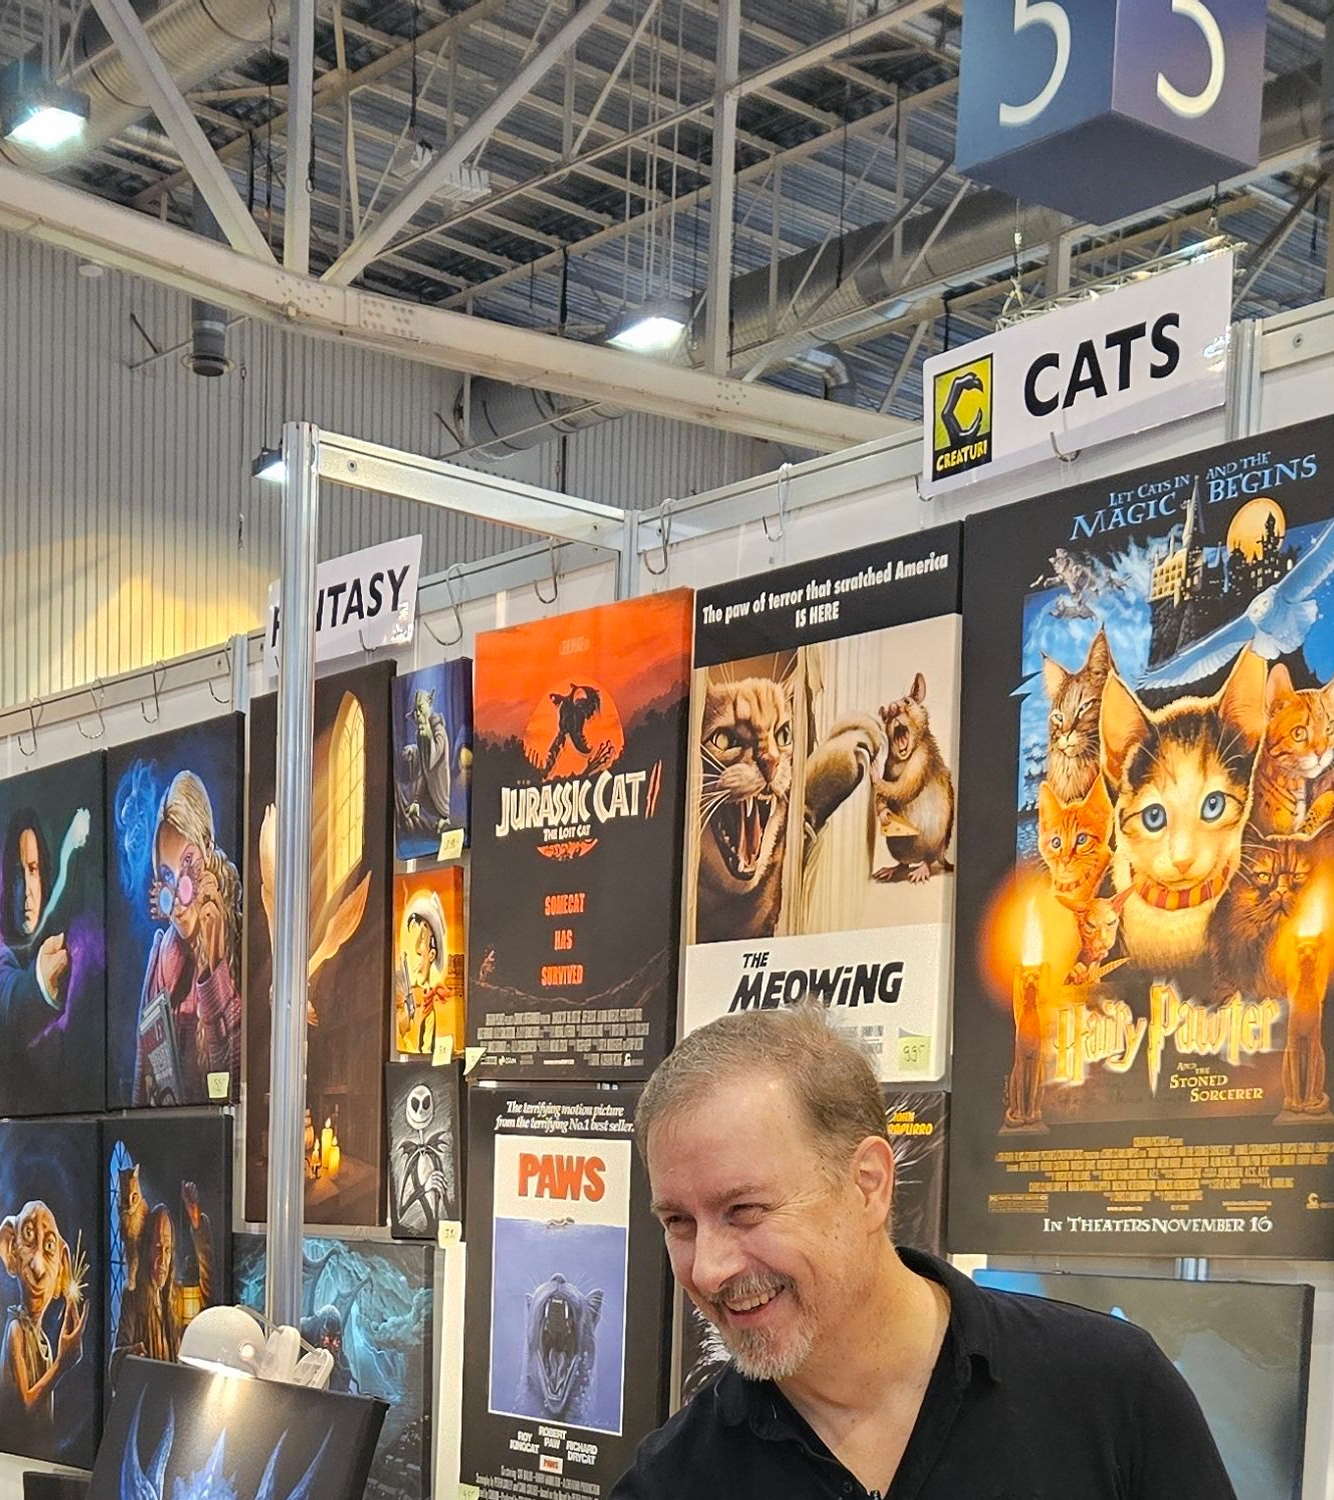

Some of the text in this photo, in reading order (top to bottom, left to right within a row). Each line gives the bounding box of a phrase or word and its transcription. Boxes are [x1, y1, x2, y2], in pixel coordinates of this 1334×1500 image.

[1024, 313, 1181, 418] CATS
[935, 439, 989, 473] CREATURI
[1206, 451, 1272, 480] AND THE
[1175, 473, 1191, 490] IN
[1207, 453, 1317, 504] BEGINS
[1069, 492, 1177, 541] MAGIC
[702, 551, 949, 624] The paw of terror that scratched America
[795, 601, 840, 628] IS HERE
[496, 770, 646, 837] JURASSIC CAT
[554, 929, 573, 951] HAS
[743, 951, 769, 969] THE
[541, 964, 584, 986] SURVIVED
[1170, 1074, 1229, 1089] STONED
[1190, 1088, 1263, 1102] SORCERER
[506, 1101, 522, 1113] The
[561, 1103, 593, 1115] motion
[593, 1103, 624, 1118] picture
[494, 1115, 515, 1130] from
[516, 1117, 530, 1129] the
[590, 1118, 608, 1132] best
[518, 1153, 606, 1202] PAWS
[1043, 1215, 1273, 1233] IN THEATERS NOVEMBER 16
